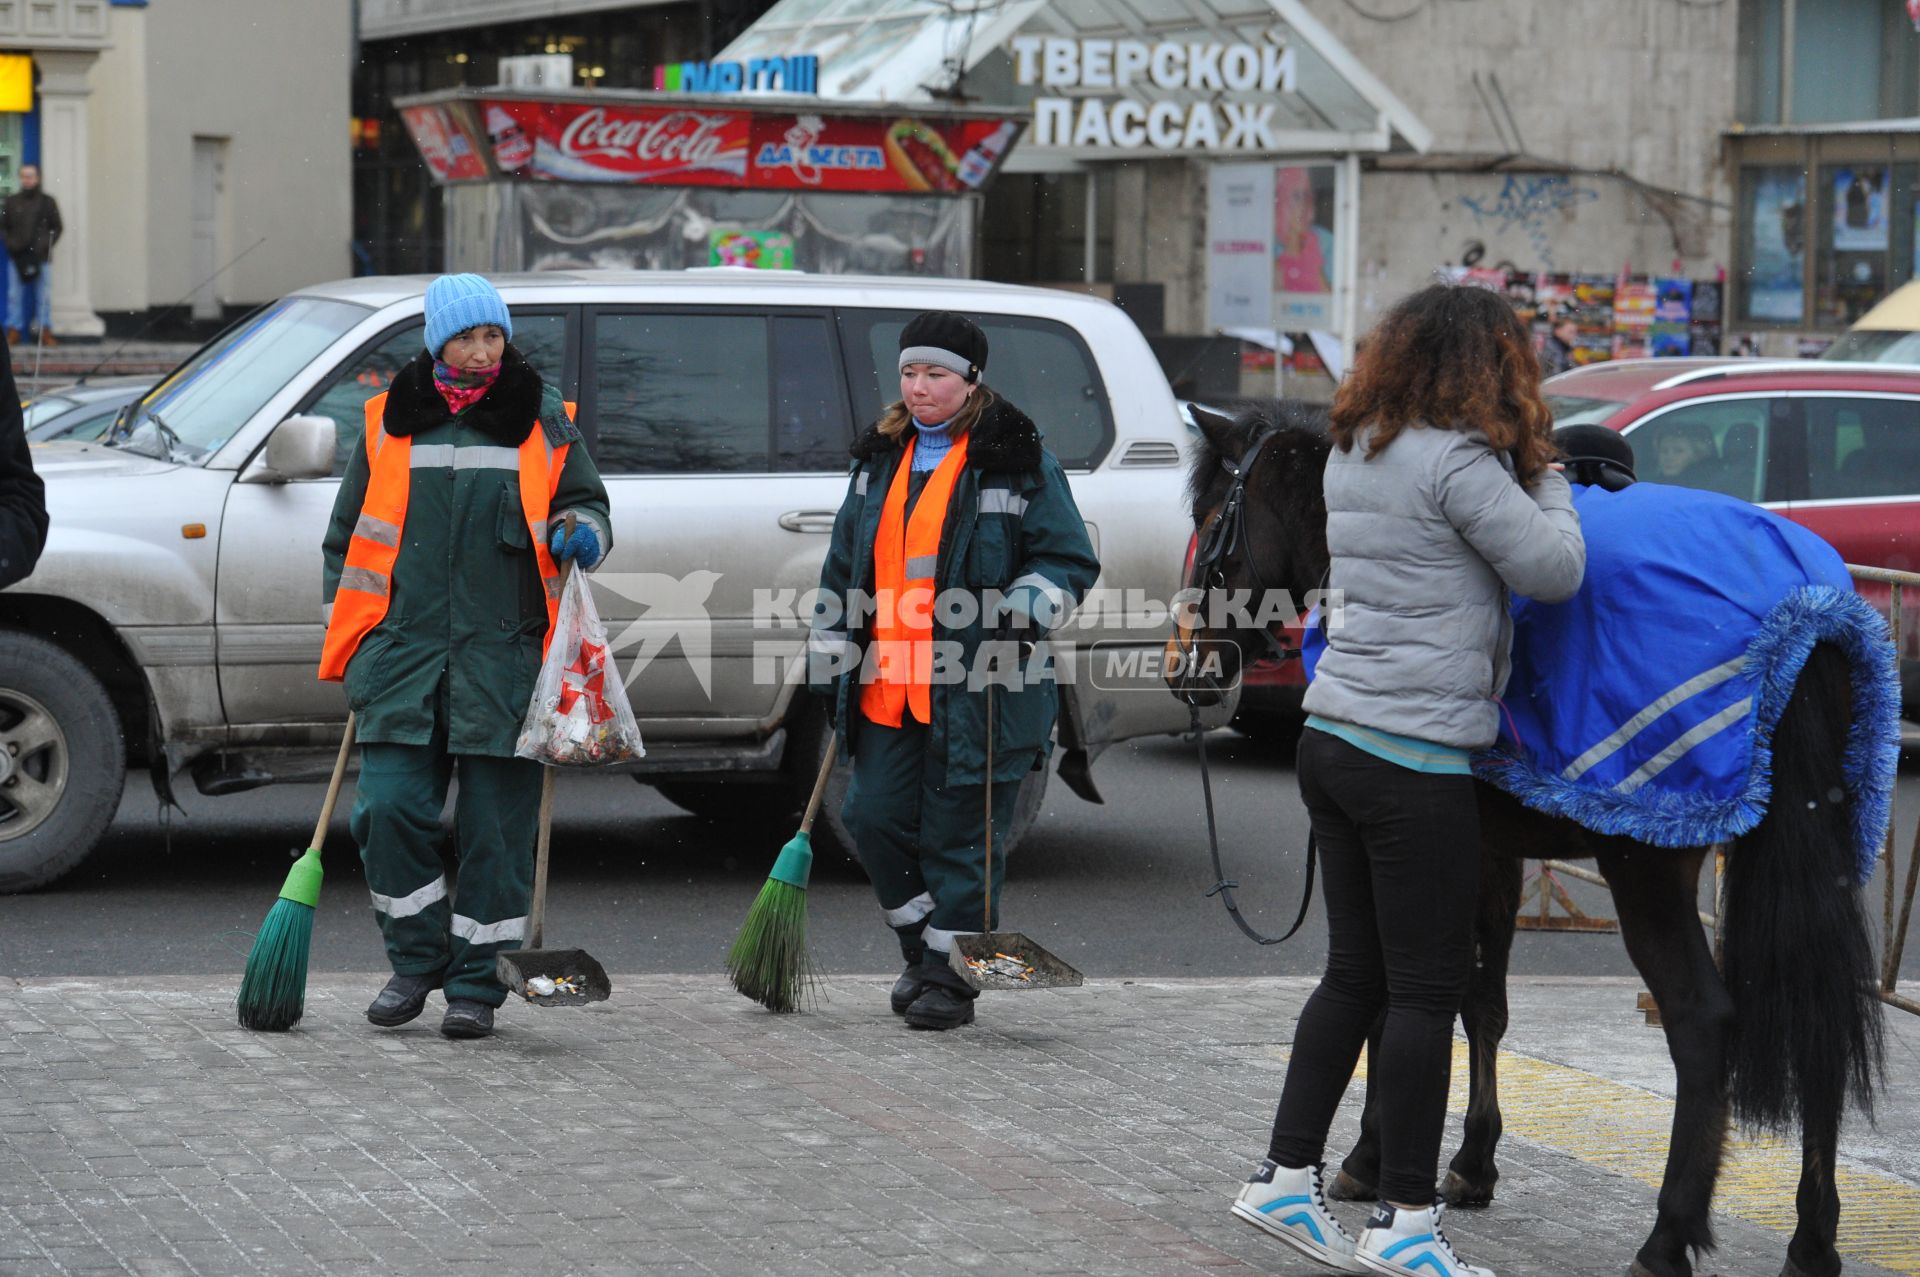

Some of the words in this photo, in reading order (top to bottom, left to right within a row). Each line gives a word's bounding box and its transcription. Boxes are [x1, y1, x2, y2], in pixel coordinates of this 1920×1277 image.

[1010, 31, 1297, 92] ТВЕРСКОЙ
[560, 107, 734, 162] Coca-Cola
[1033, 97, 1277, 150] ПАССАЖ
